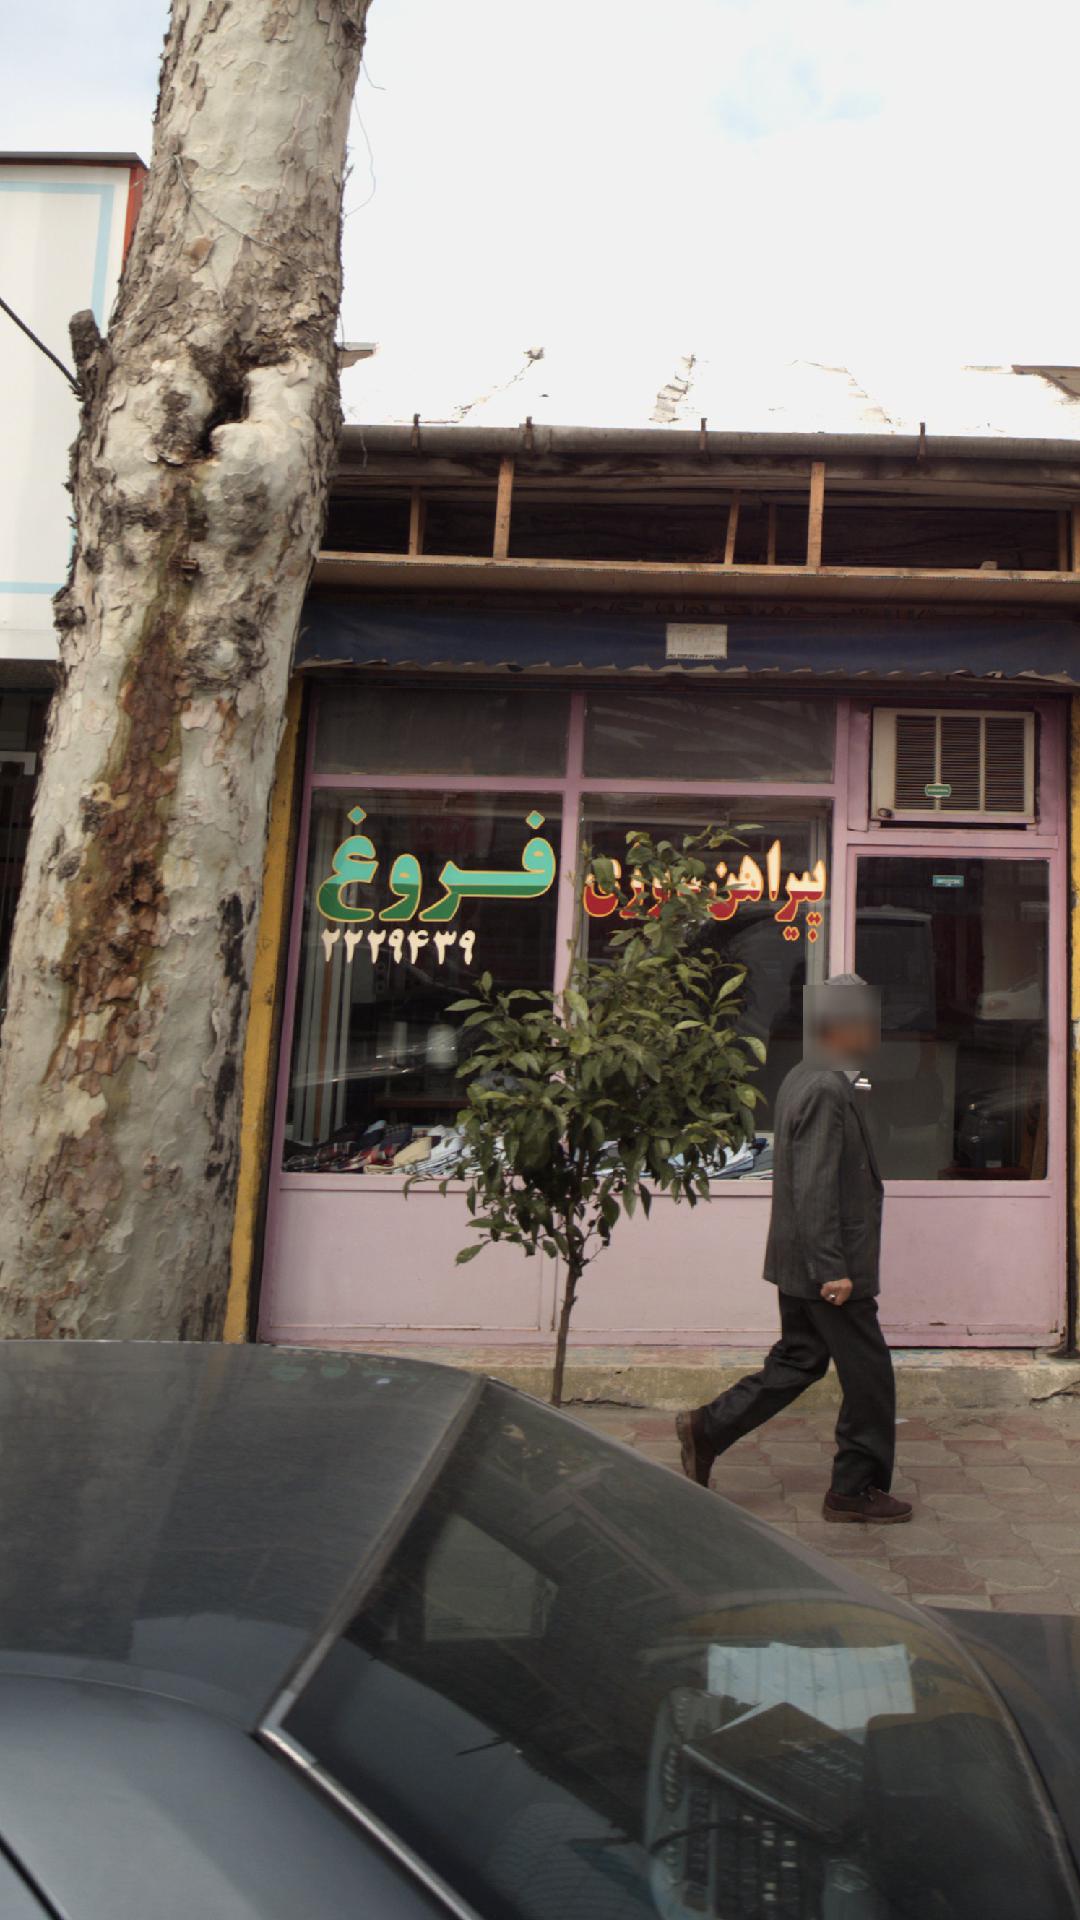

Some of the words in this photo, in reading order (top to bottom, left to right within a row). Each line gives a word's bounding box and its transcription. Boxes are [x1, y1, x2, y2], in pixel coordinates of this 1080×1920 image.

[316, 805, 557, 922] فروغ
[583, 842, 702, 919] وزی
[706, 839, 827, 943] پیراهن
[321, 928, 476, 965] ۲۲۲۹۴۳۹
